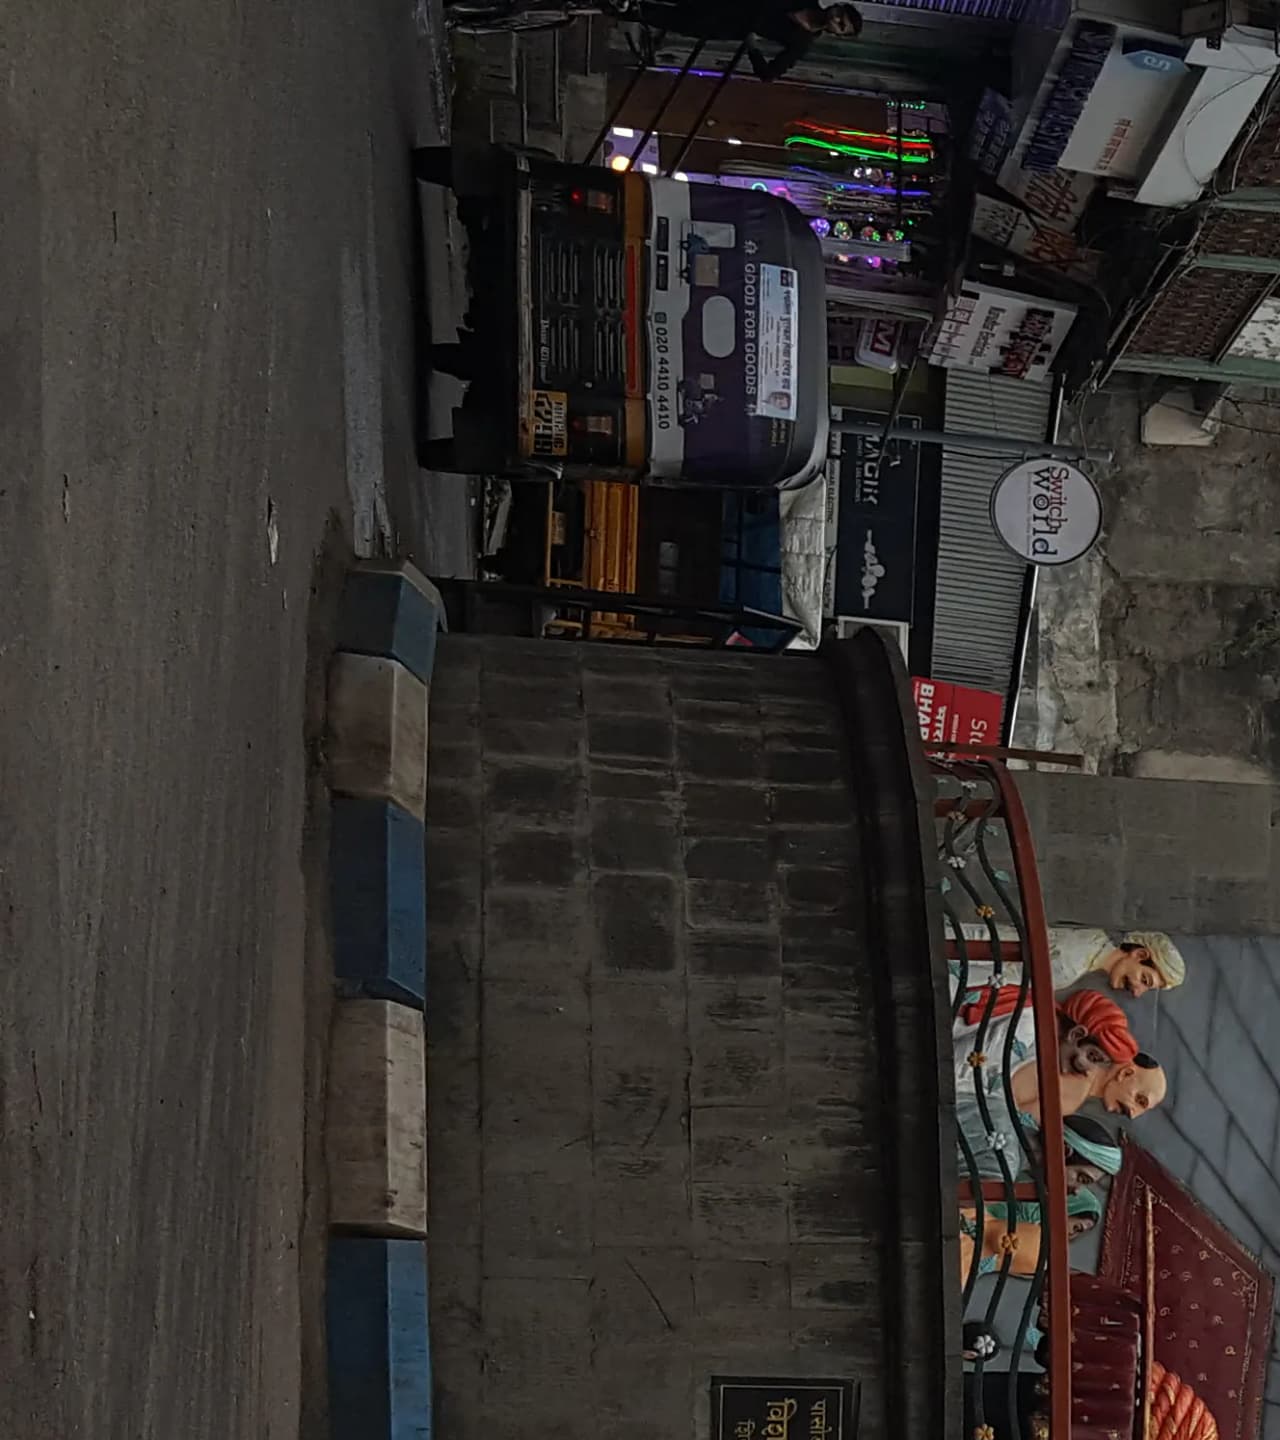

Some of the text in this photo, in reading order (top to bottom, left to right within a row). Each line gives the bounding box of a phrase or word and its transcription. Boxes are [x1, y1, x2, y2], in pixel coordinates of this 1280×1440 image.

[744, 263, 757, 395] GOOD FOR GOODS
[656, 327, 670, 430] 020 4410 4410
[1032, 467, 1058, 556] world
[1047, 467, 1070, 530] Switch
